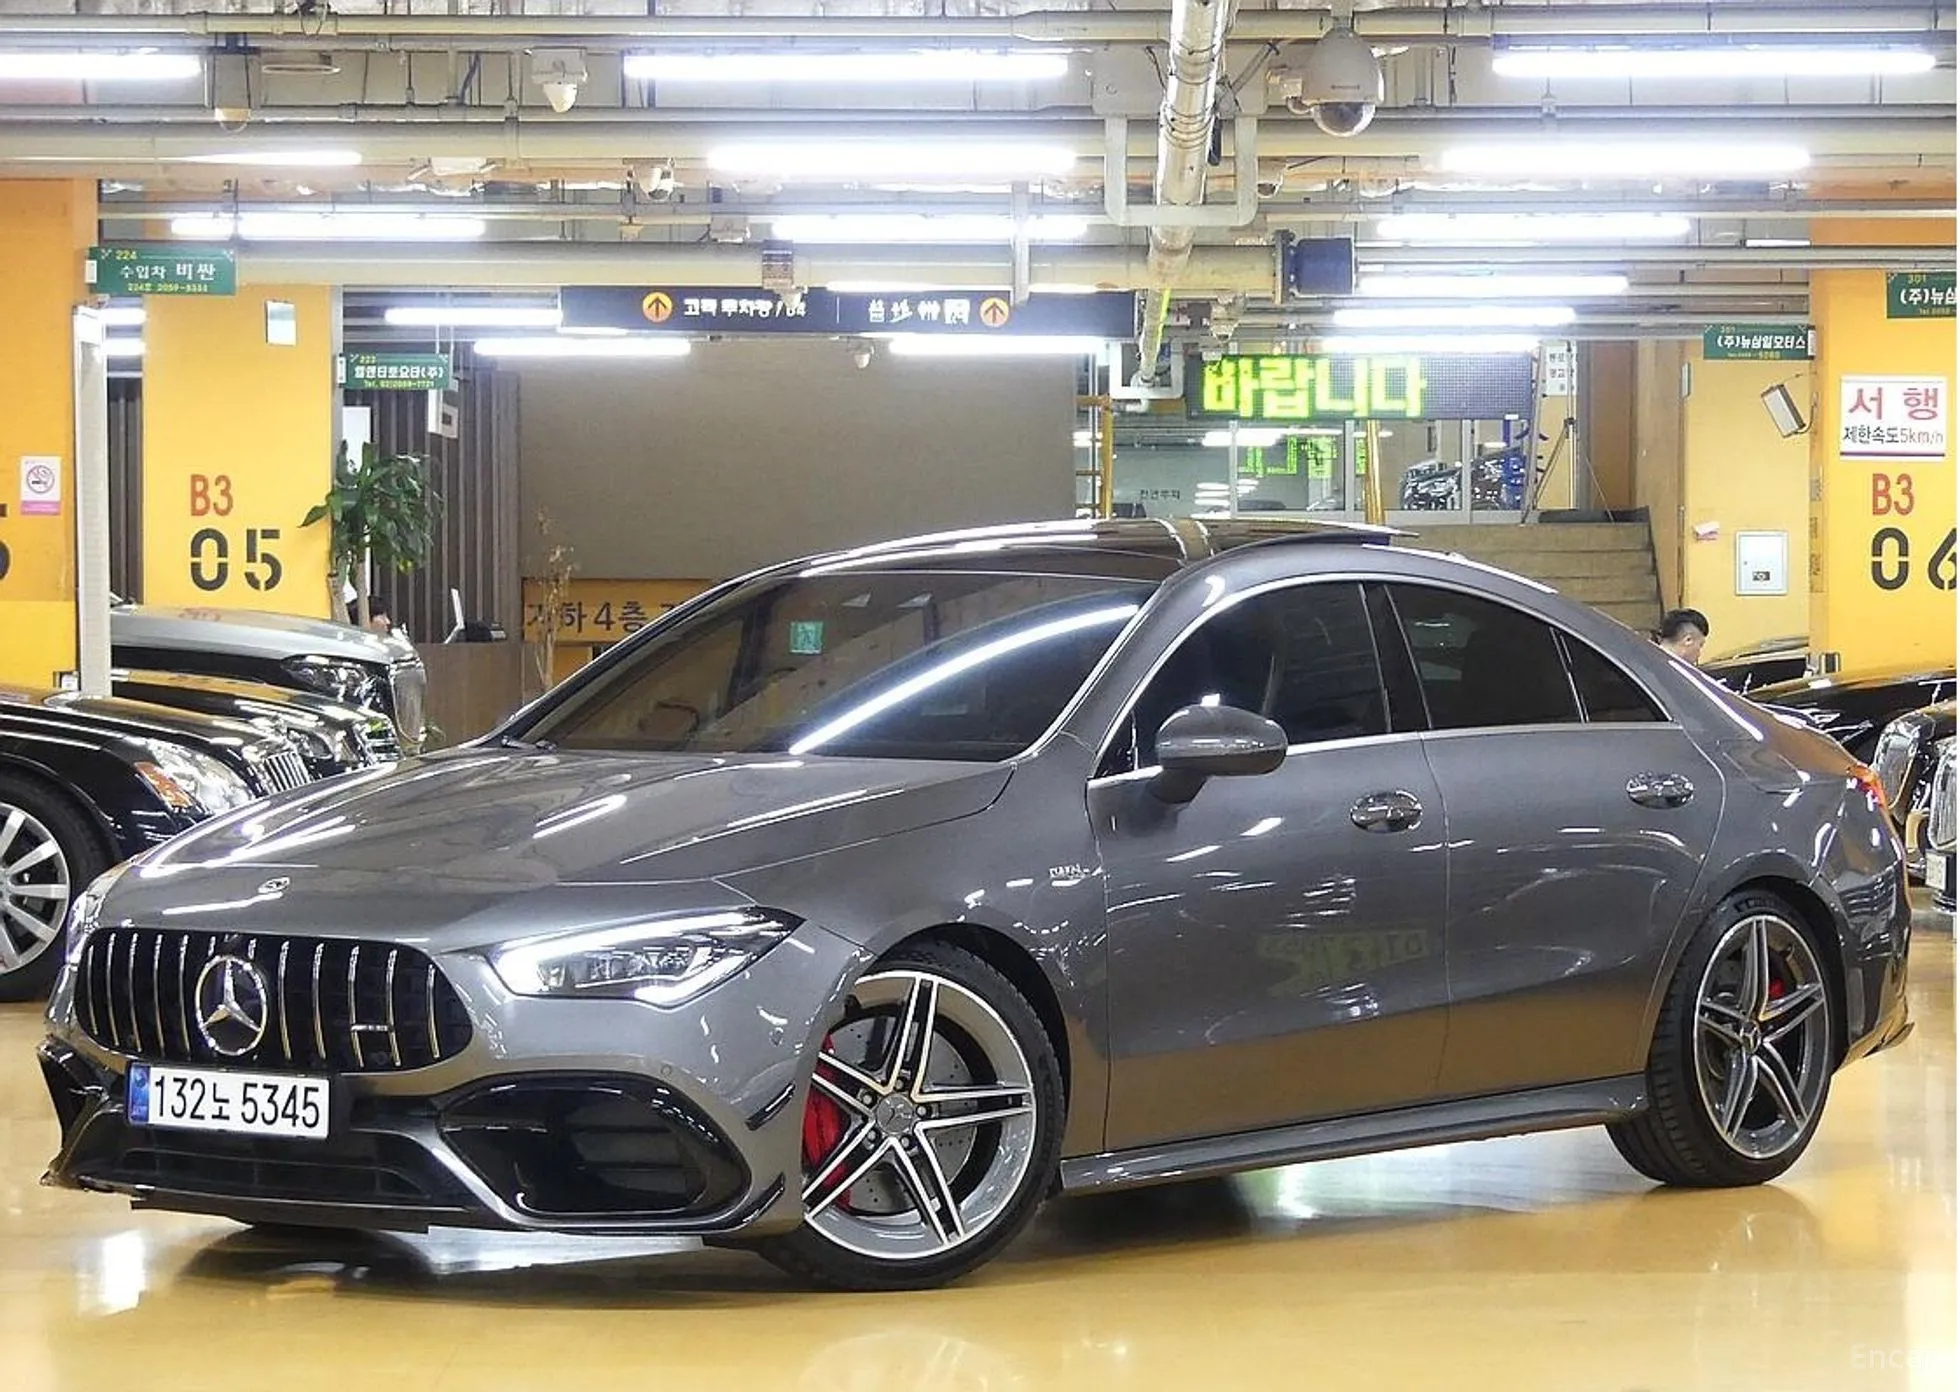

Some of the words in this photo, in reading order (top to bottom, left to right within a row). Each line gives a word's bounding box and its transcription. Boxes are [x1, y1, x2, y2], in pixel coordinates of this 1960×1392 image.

[115, 250, 138, 261] 224
[120, 264, 167, 280] 수입차
[1203, 356, 1428, 418] 바랍니다
[190, 474, 234, 517] B3
[1872, 473, 1915, 515] B3
[190, 527, 283, 592] 05
[154, 1075, 230, 1121] 132노
[241, 1082, 320, 1129] 5345
